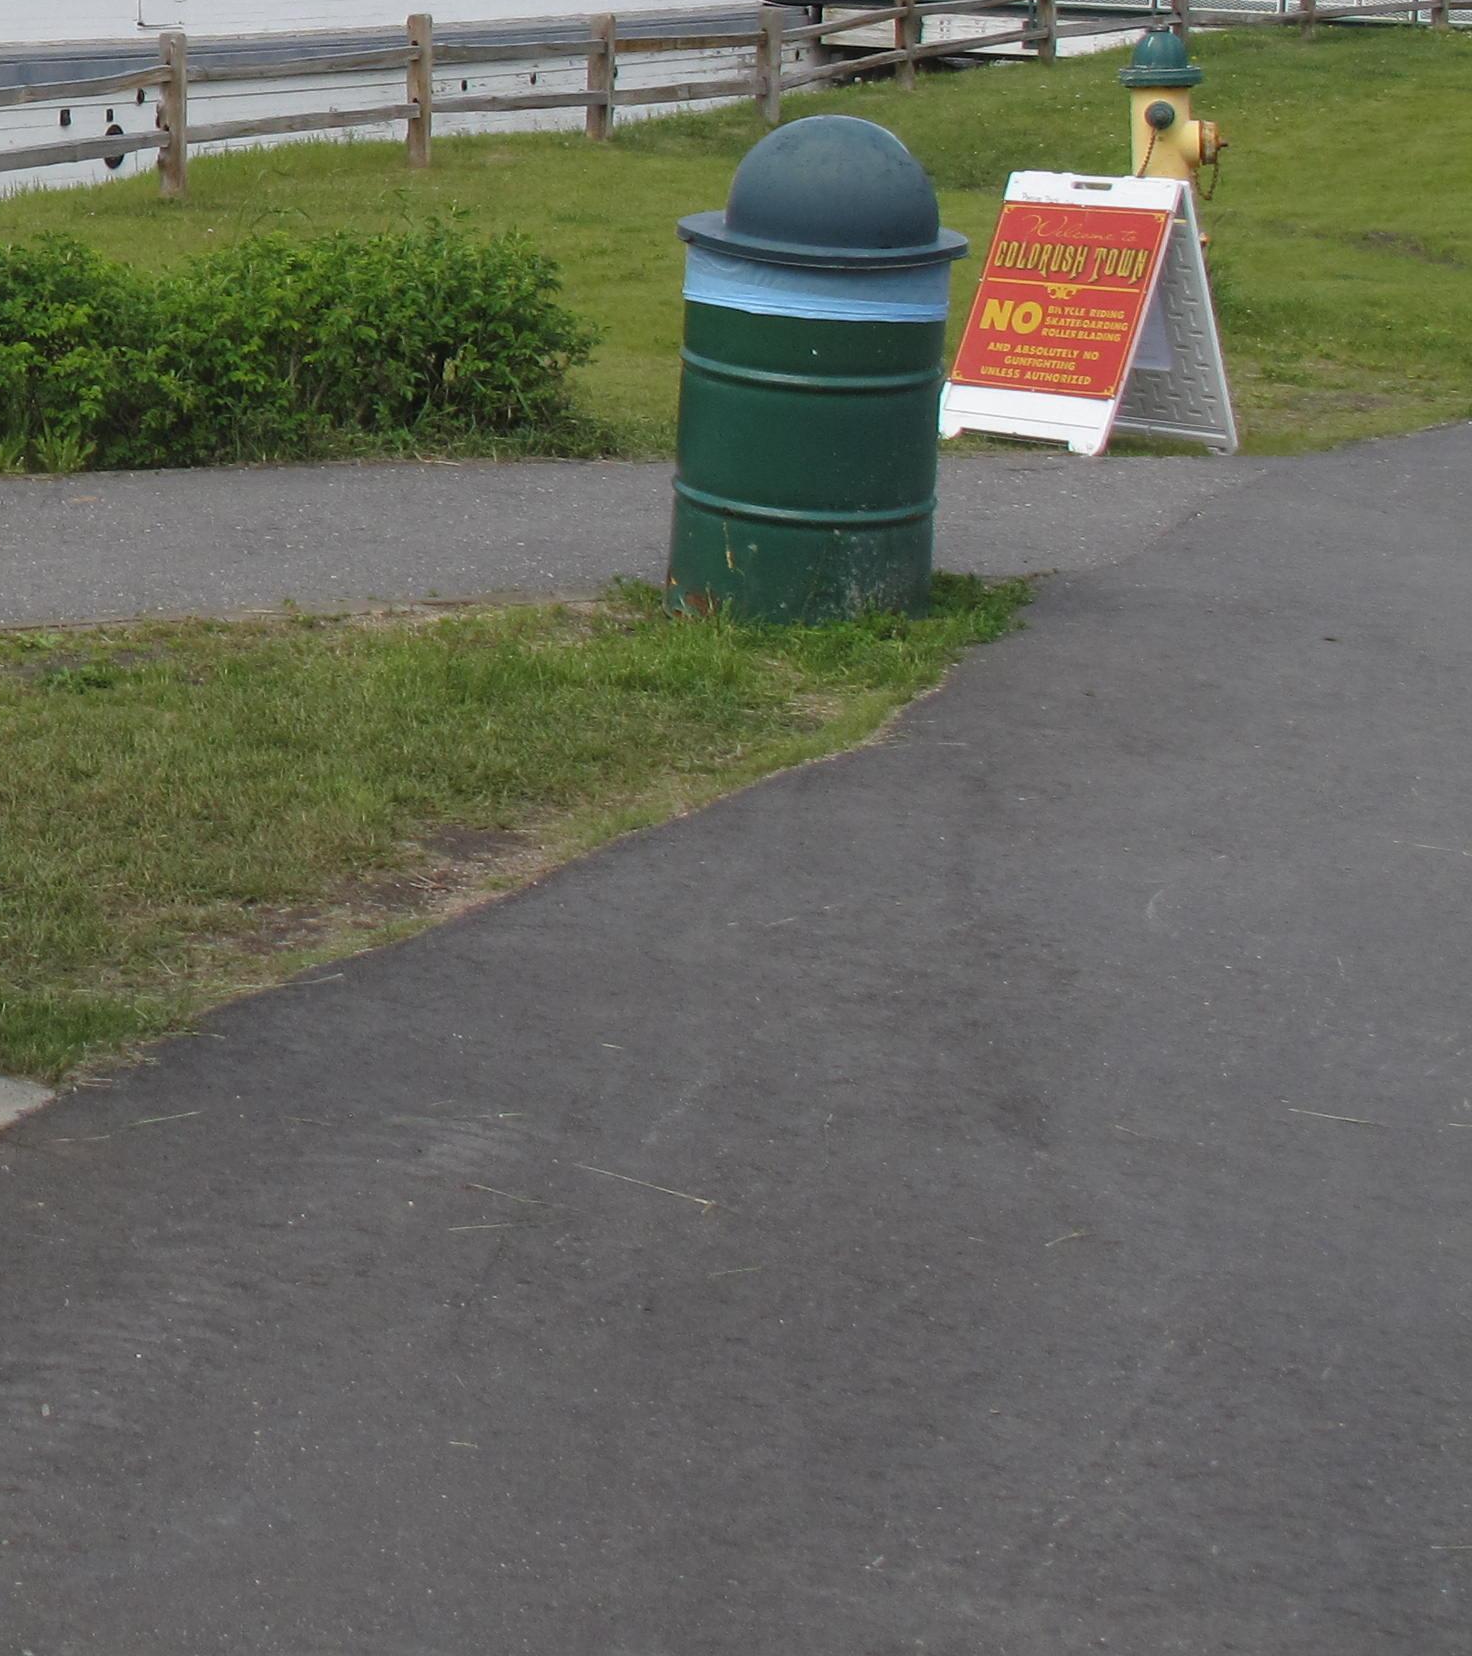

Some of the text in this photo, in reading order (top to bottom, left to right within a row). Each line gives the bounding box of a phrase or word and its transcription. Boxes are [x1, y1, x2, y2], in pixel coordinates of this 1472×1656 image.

[1022, 214, 1114, 241] Welcome
[994, 240, 1148, 285] GOLDRUSH TOWN
[979, 298, 1043, 335] NO
[1089, 309, 1125, 319] RIDING
[1044, 316, 1129, 331] SKATEBOARDING
[987, 342, 1100, 360] AND ABSOLUTELY NO
[1004, 356, 1076, 371] GUNFIGHTING
[980, 366, 1092, 385] UNLESS AUTHORIZED
